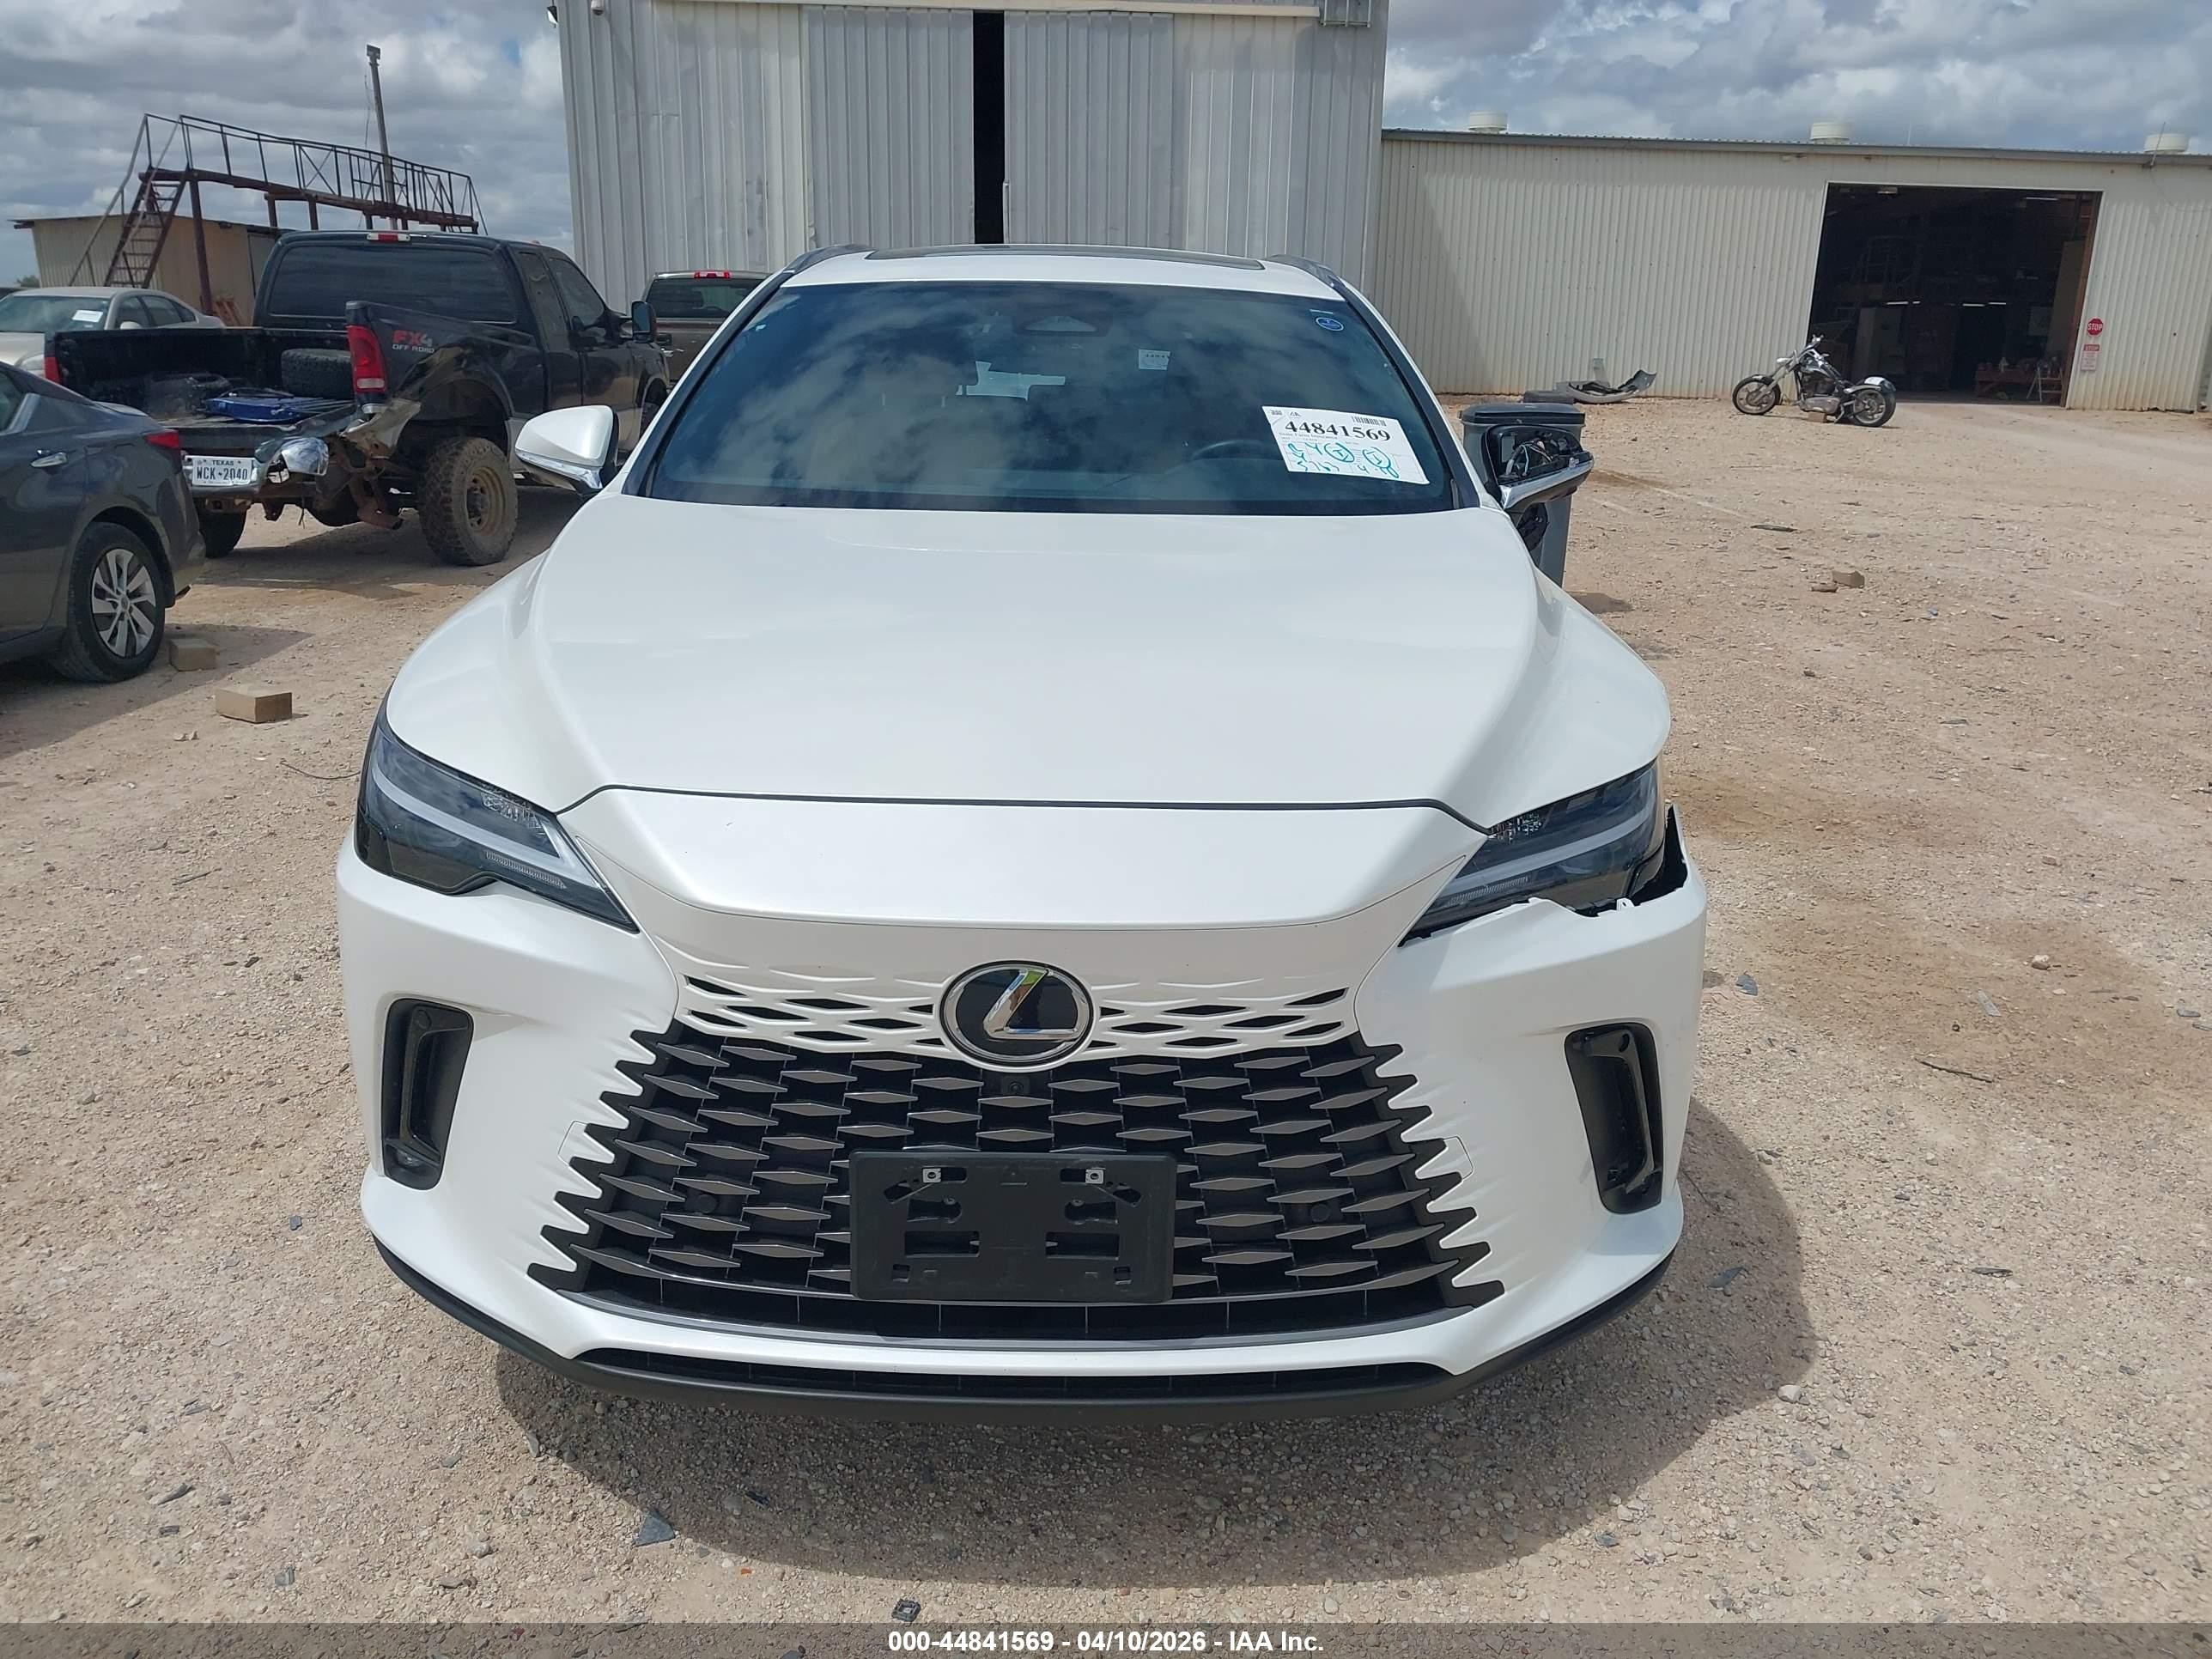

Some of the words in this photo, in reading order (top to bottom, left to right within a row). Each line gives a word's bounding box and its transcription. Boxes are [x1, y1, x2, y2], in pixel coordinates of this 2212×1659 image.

[2087, 323, 2103, 331] STOP
[393, 330, 433, 346] FX4
[1285, 421, 1391, 441] 44841569
